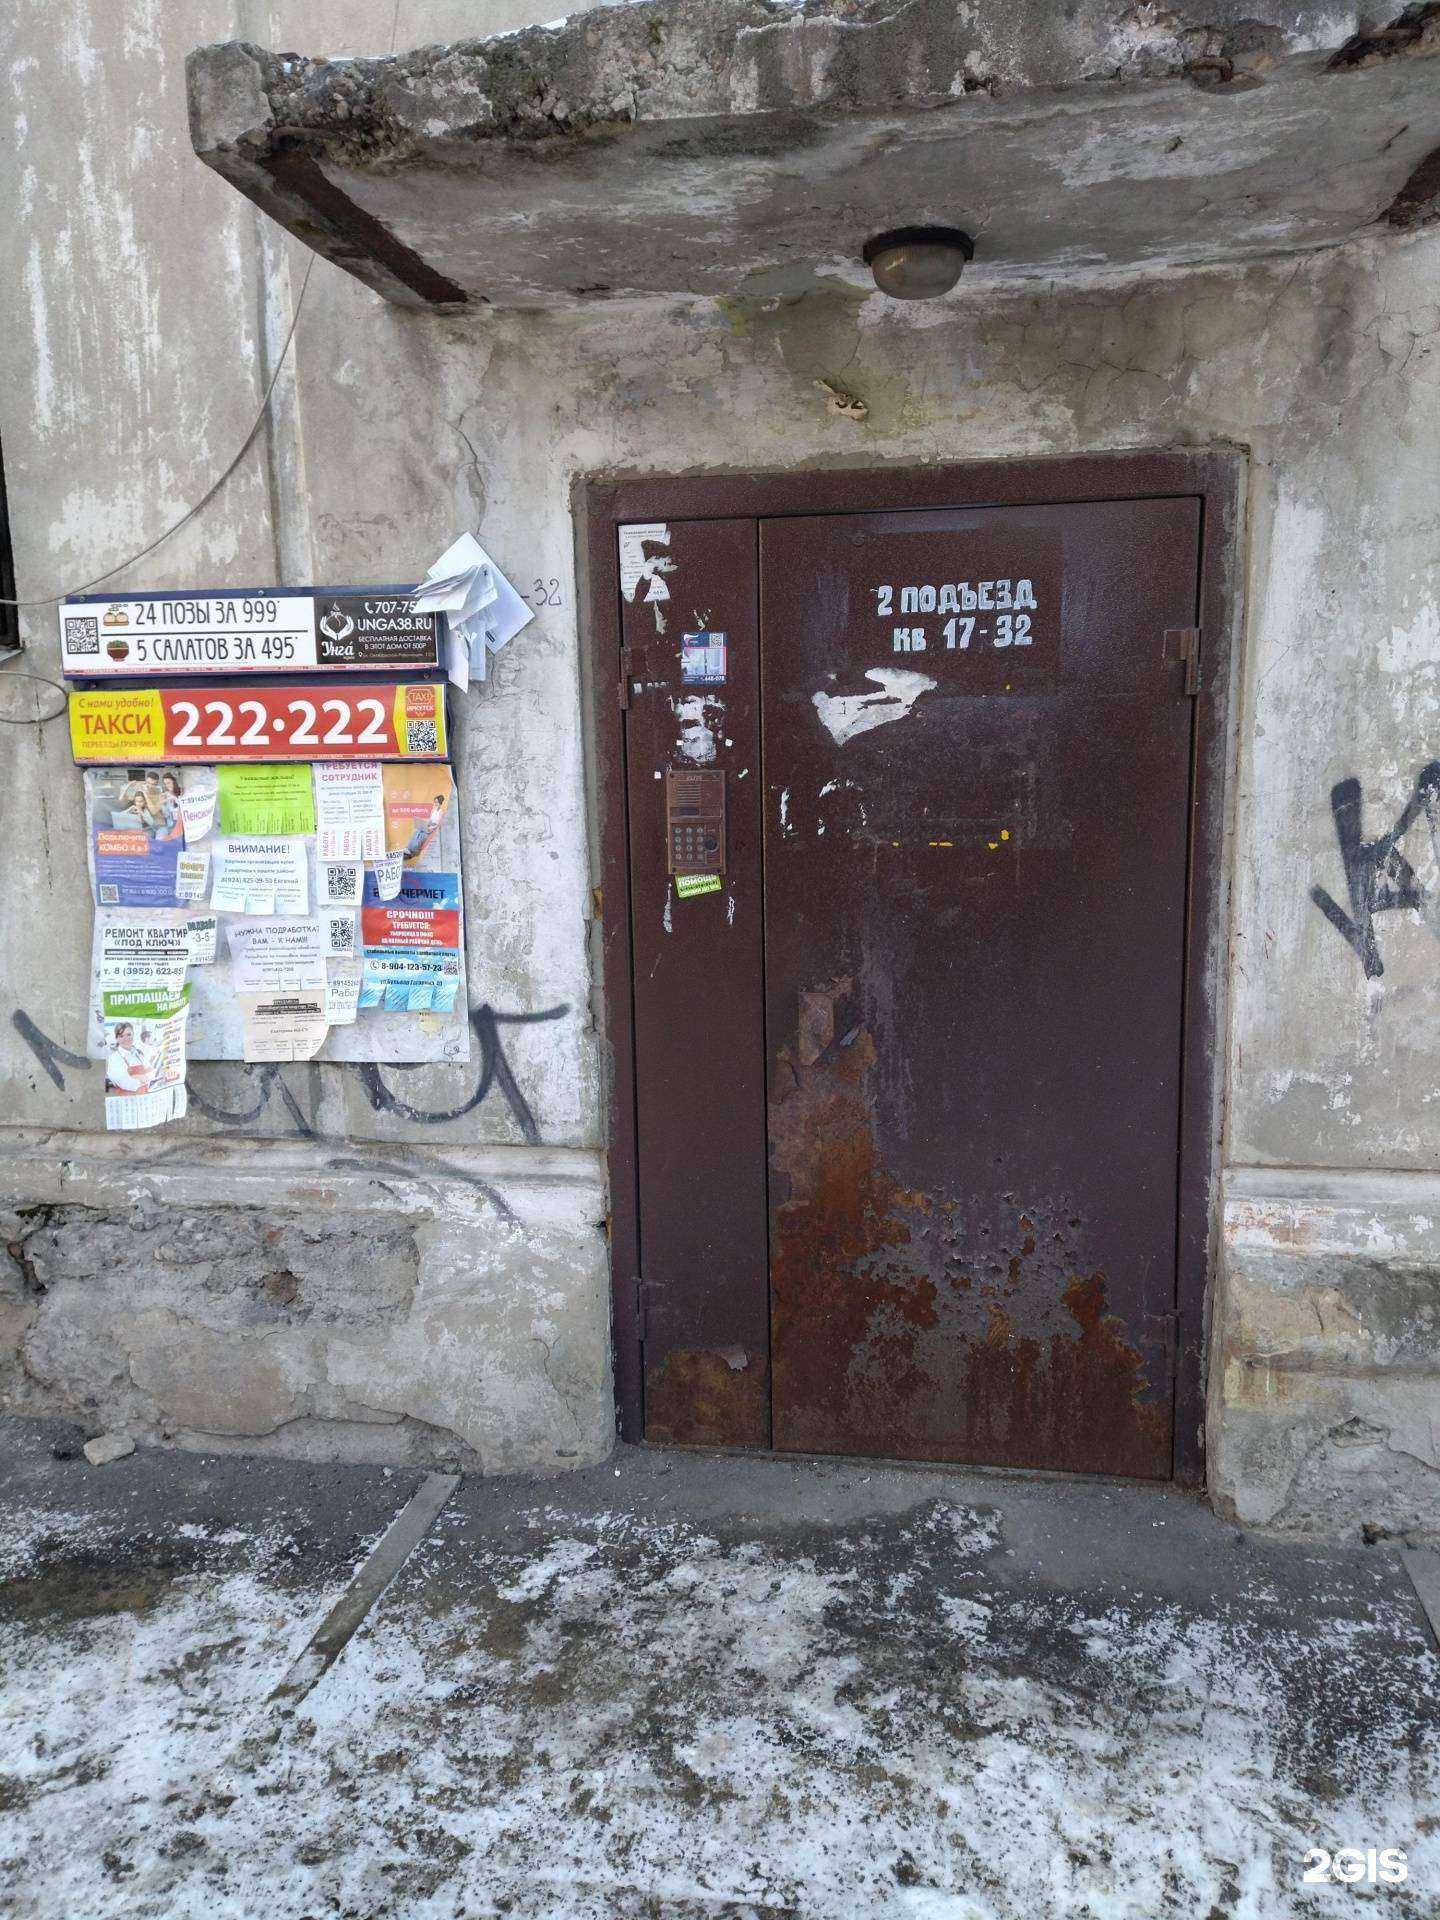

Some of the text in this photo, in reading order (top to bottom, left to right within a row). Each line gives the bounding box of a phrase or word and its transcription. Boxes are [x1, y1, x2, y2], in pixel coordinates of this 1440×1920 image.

[877, 579, 1038, 616] 2 ПОДЪЕЗД
[135, 603, 156, 625] 24
[163, 602, 210, 625] ПОЗЫ
[216, 601, 238, 624] ЗА
[357, 618, 432, 631] UNGA38.RU
[137, 639, 147, 661] 5
[153, 638, 229, 661] САЛАТОВ
[234, 637, 256, 660] ЗА
[78, 697, 155, 711] С нами удобно!
[80, 714, 153, 736] ТАКСИ
[320, 761, 378, 770] ТРЕБУЕТСЯ
[321, 773, 378, 782] СОТРУДНИК
[228, 844, 291, 854] ВНИМАНИЕ!
[386, 910, 435, 919] СРОЧНО!!!
[105, 928, 188, 938] РЕМОНТ КВАРТИР
[114, 939, 181, 948] «ПОД КЛЮЧ»
[114, 967, 120, 975] 8
[123, 967, 154, 976] (3952)
